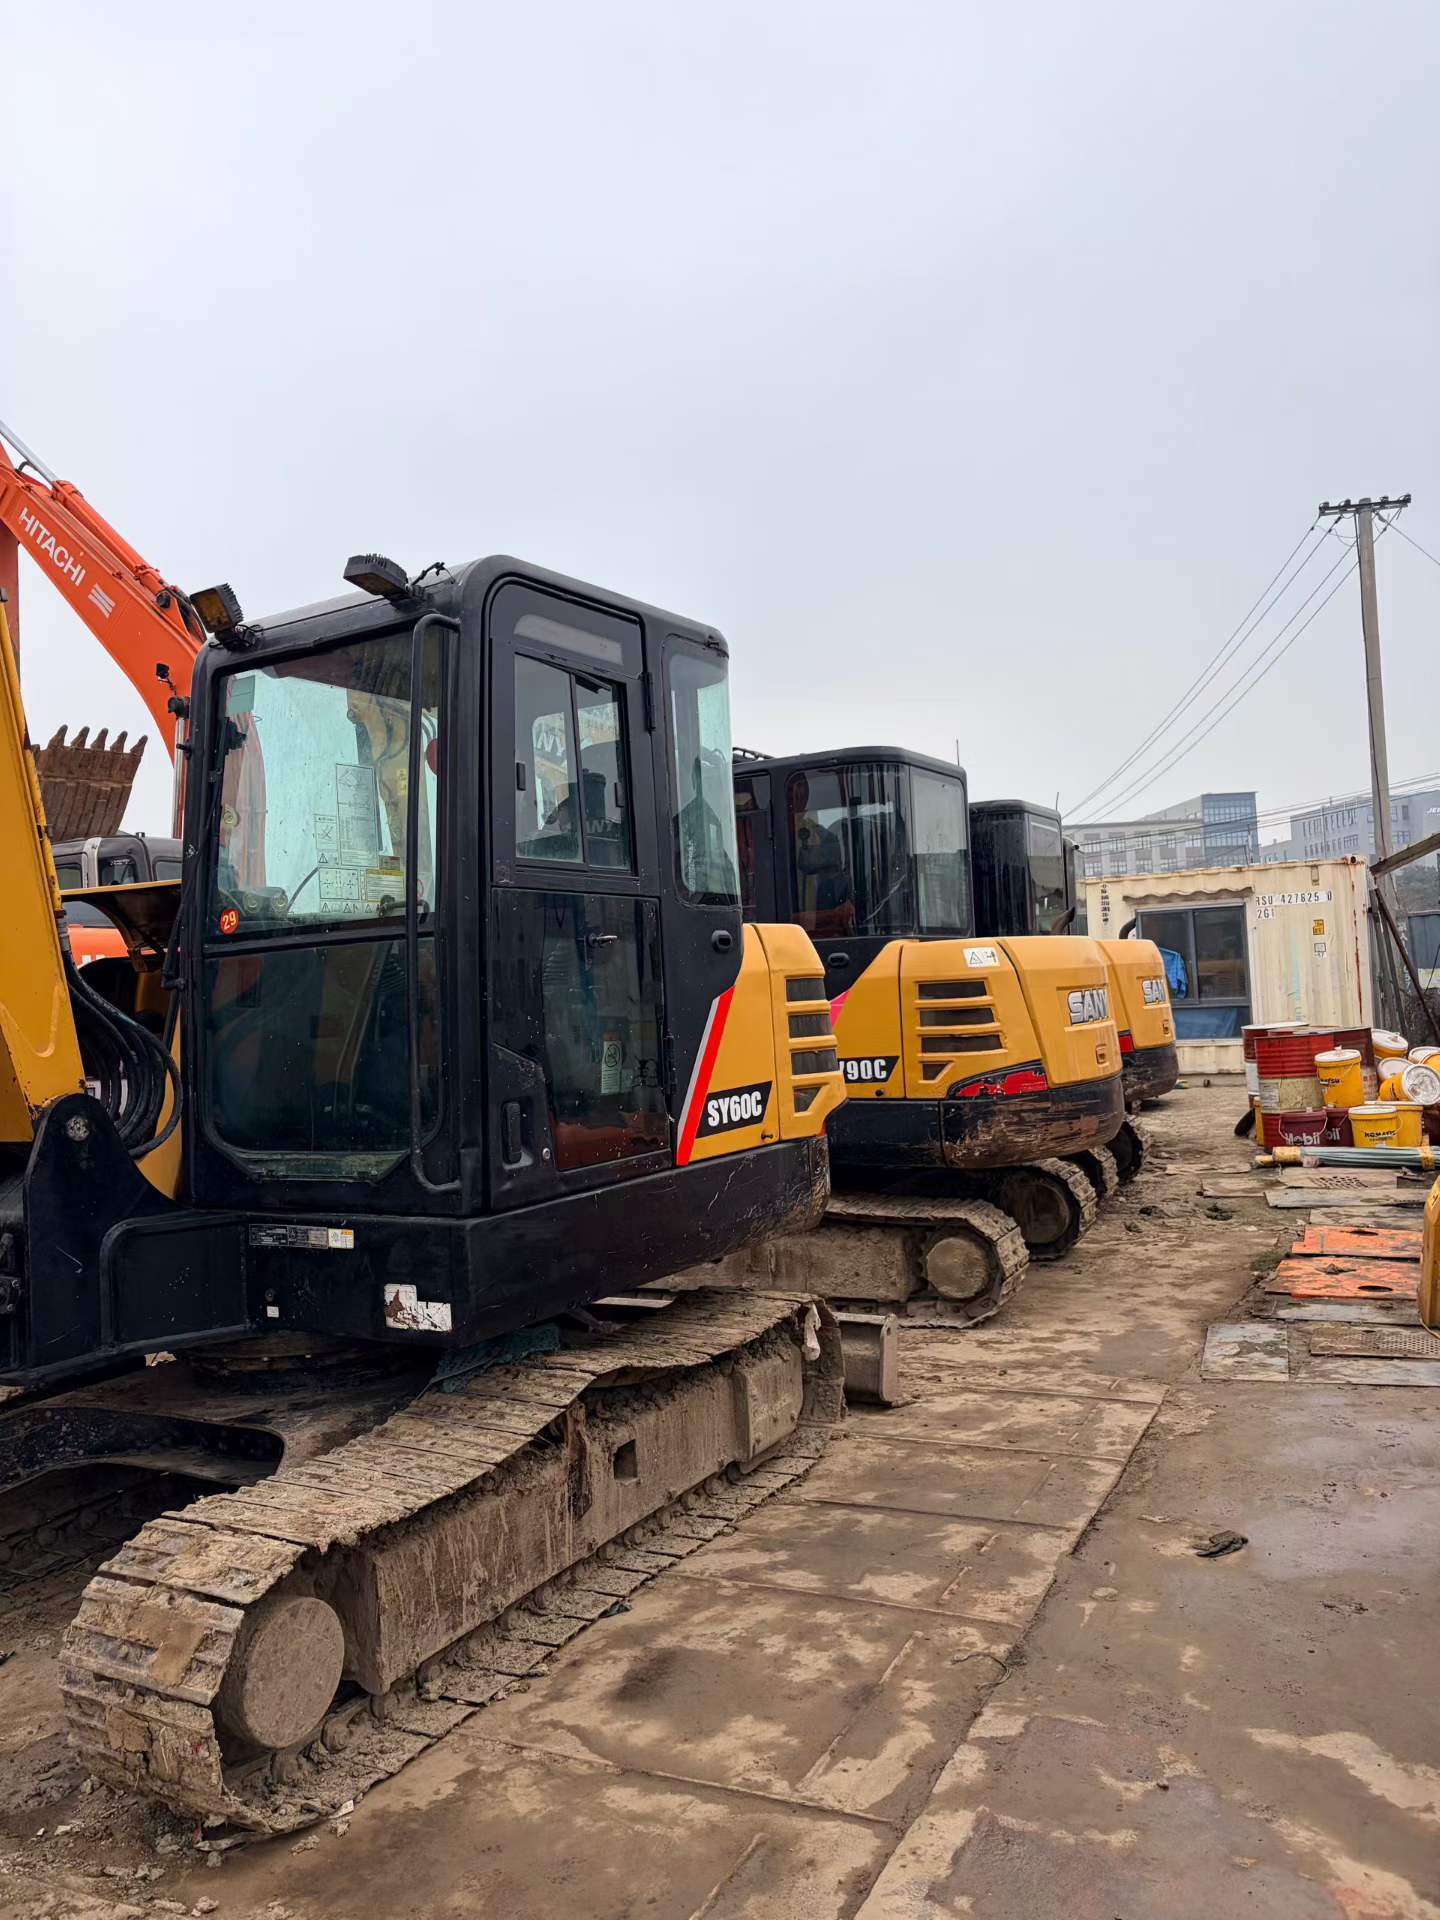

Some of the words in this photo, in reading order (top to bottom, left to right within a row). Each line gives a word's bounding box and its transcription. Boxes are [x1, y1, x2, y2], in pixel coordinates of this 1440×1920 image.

[19, 507, 86, 587] HITACHI
[222, 911, 237, 930] 29
[707, 1091, 763, 1127] SY60C
